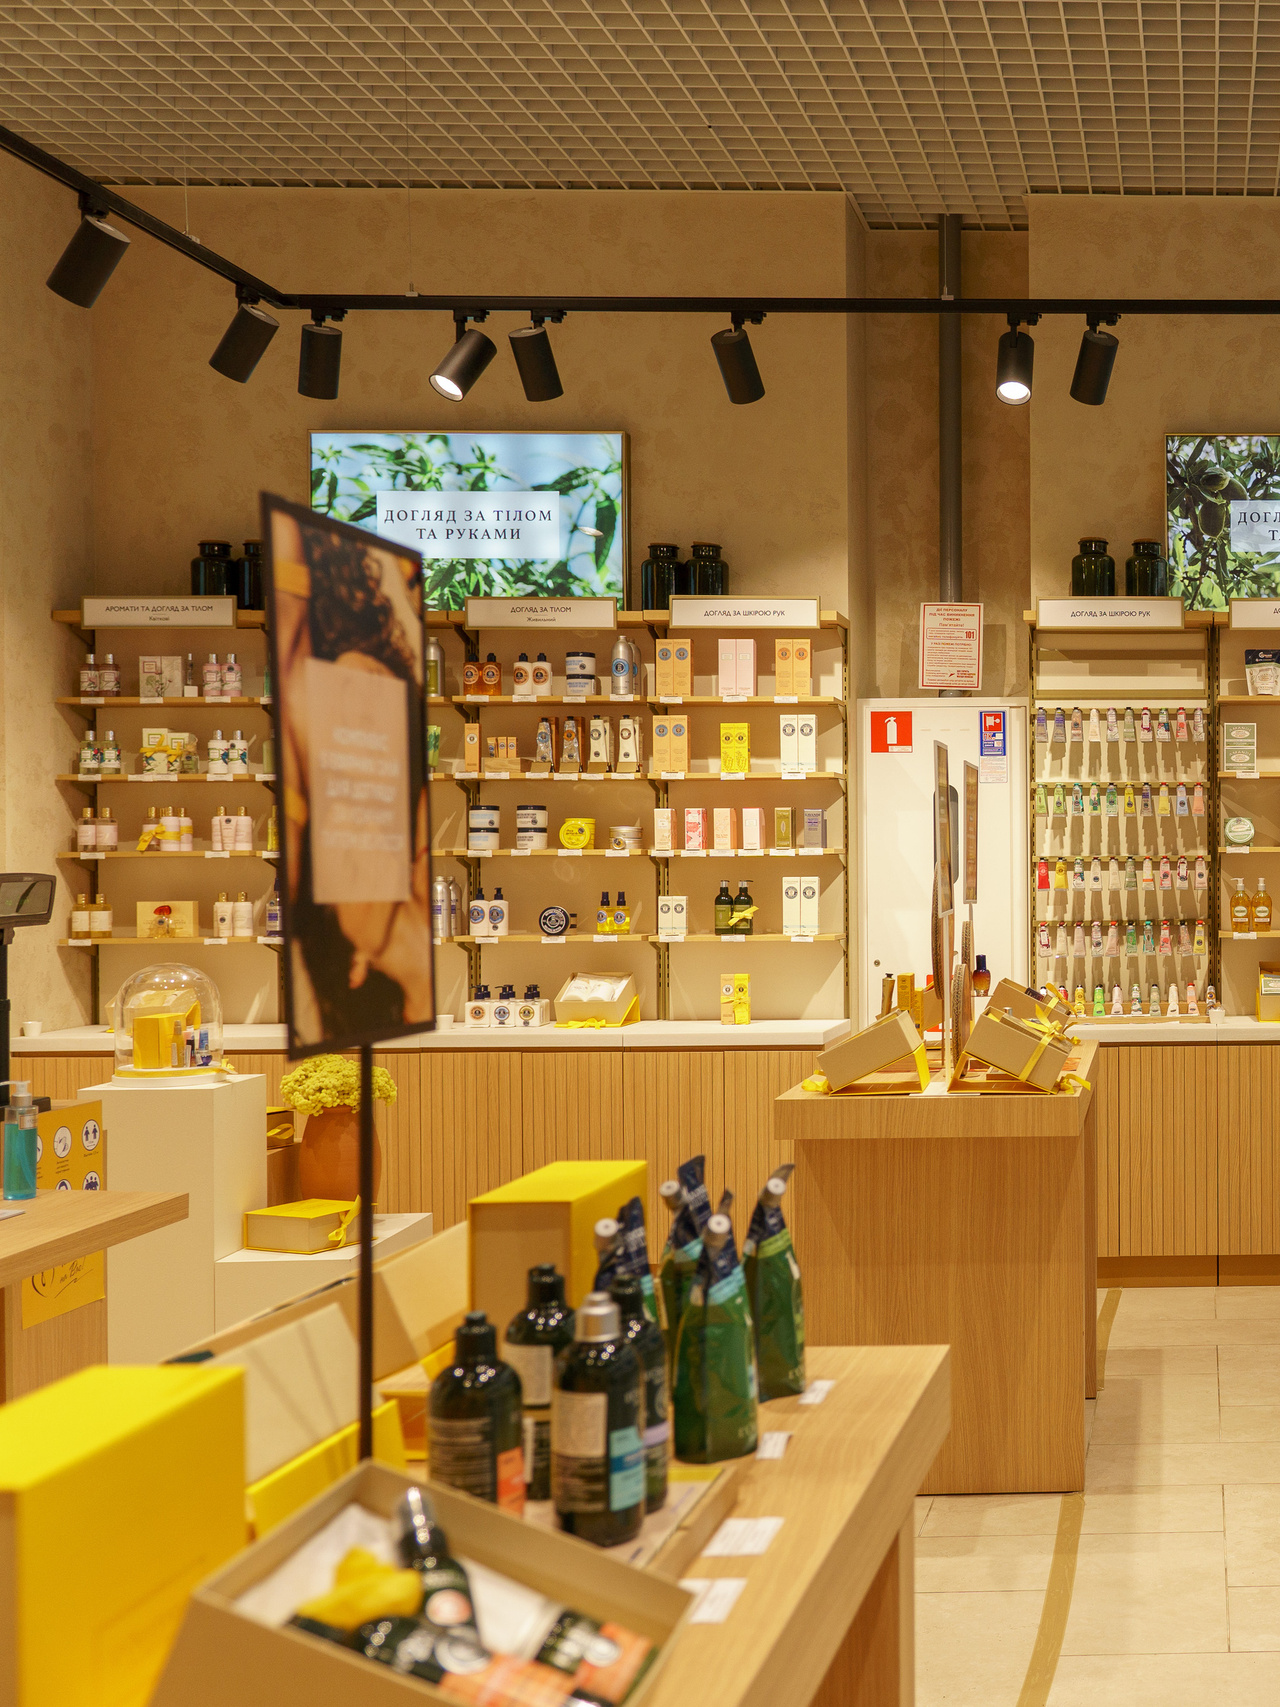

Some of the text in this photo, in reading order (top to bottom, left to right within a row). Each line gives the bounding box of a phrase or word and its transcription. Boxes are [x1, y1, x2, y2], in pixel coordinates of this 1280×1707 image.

[384, 509, 553, 524] ДОГЛЯД ЗА ТІЛОМ
[415, 528, 521, 540] ТА РУКАМИ
[151, 605, 180, 613] ДОГЛЯД
[965, 630, 975, 639] 101
